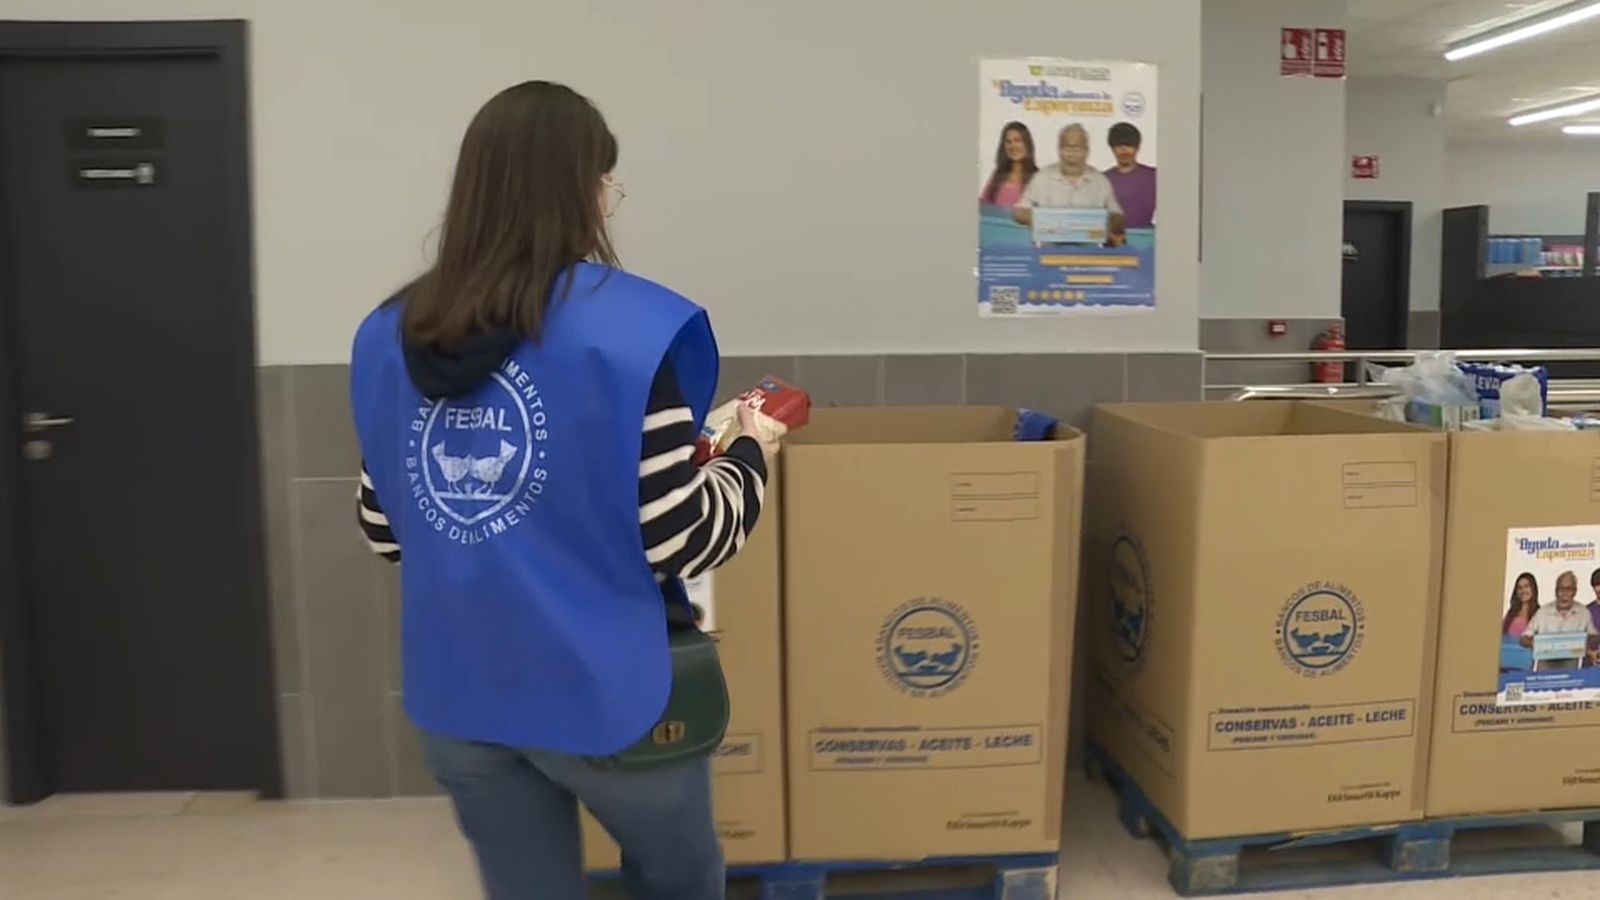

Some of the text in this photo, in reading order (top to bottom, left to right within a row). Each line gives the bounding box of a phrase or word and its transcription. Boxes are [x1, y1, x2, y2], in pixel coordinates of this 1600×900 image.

[406, 456, 447, 532] BANCOS
[1295, 608, 1346, 622] FESBAL
[1215, 717, 1298, 733] CONSERVAS
[1307, 713, 1355, 728] ACEITE
[1365, 708, 1407, 724] LECHE
[815, 739, 906, 754] CONSERVAS
[918, 736, 973, 752] ACEITE
[984, 733, 1034, 749] LECHE
